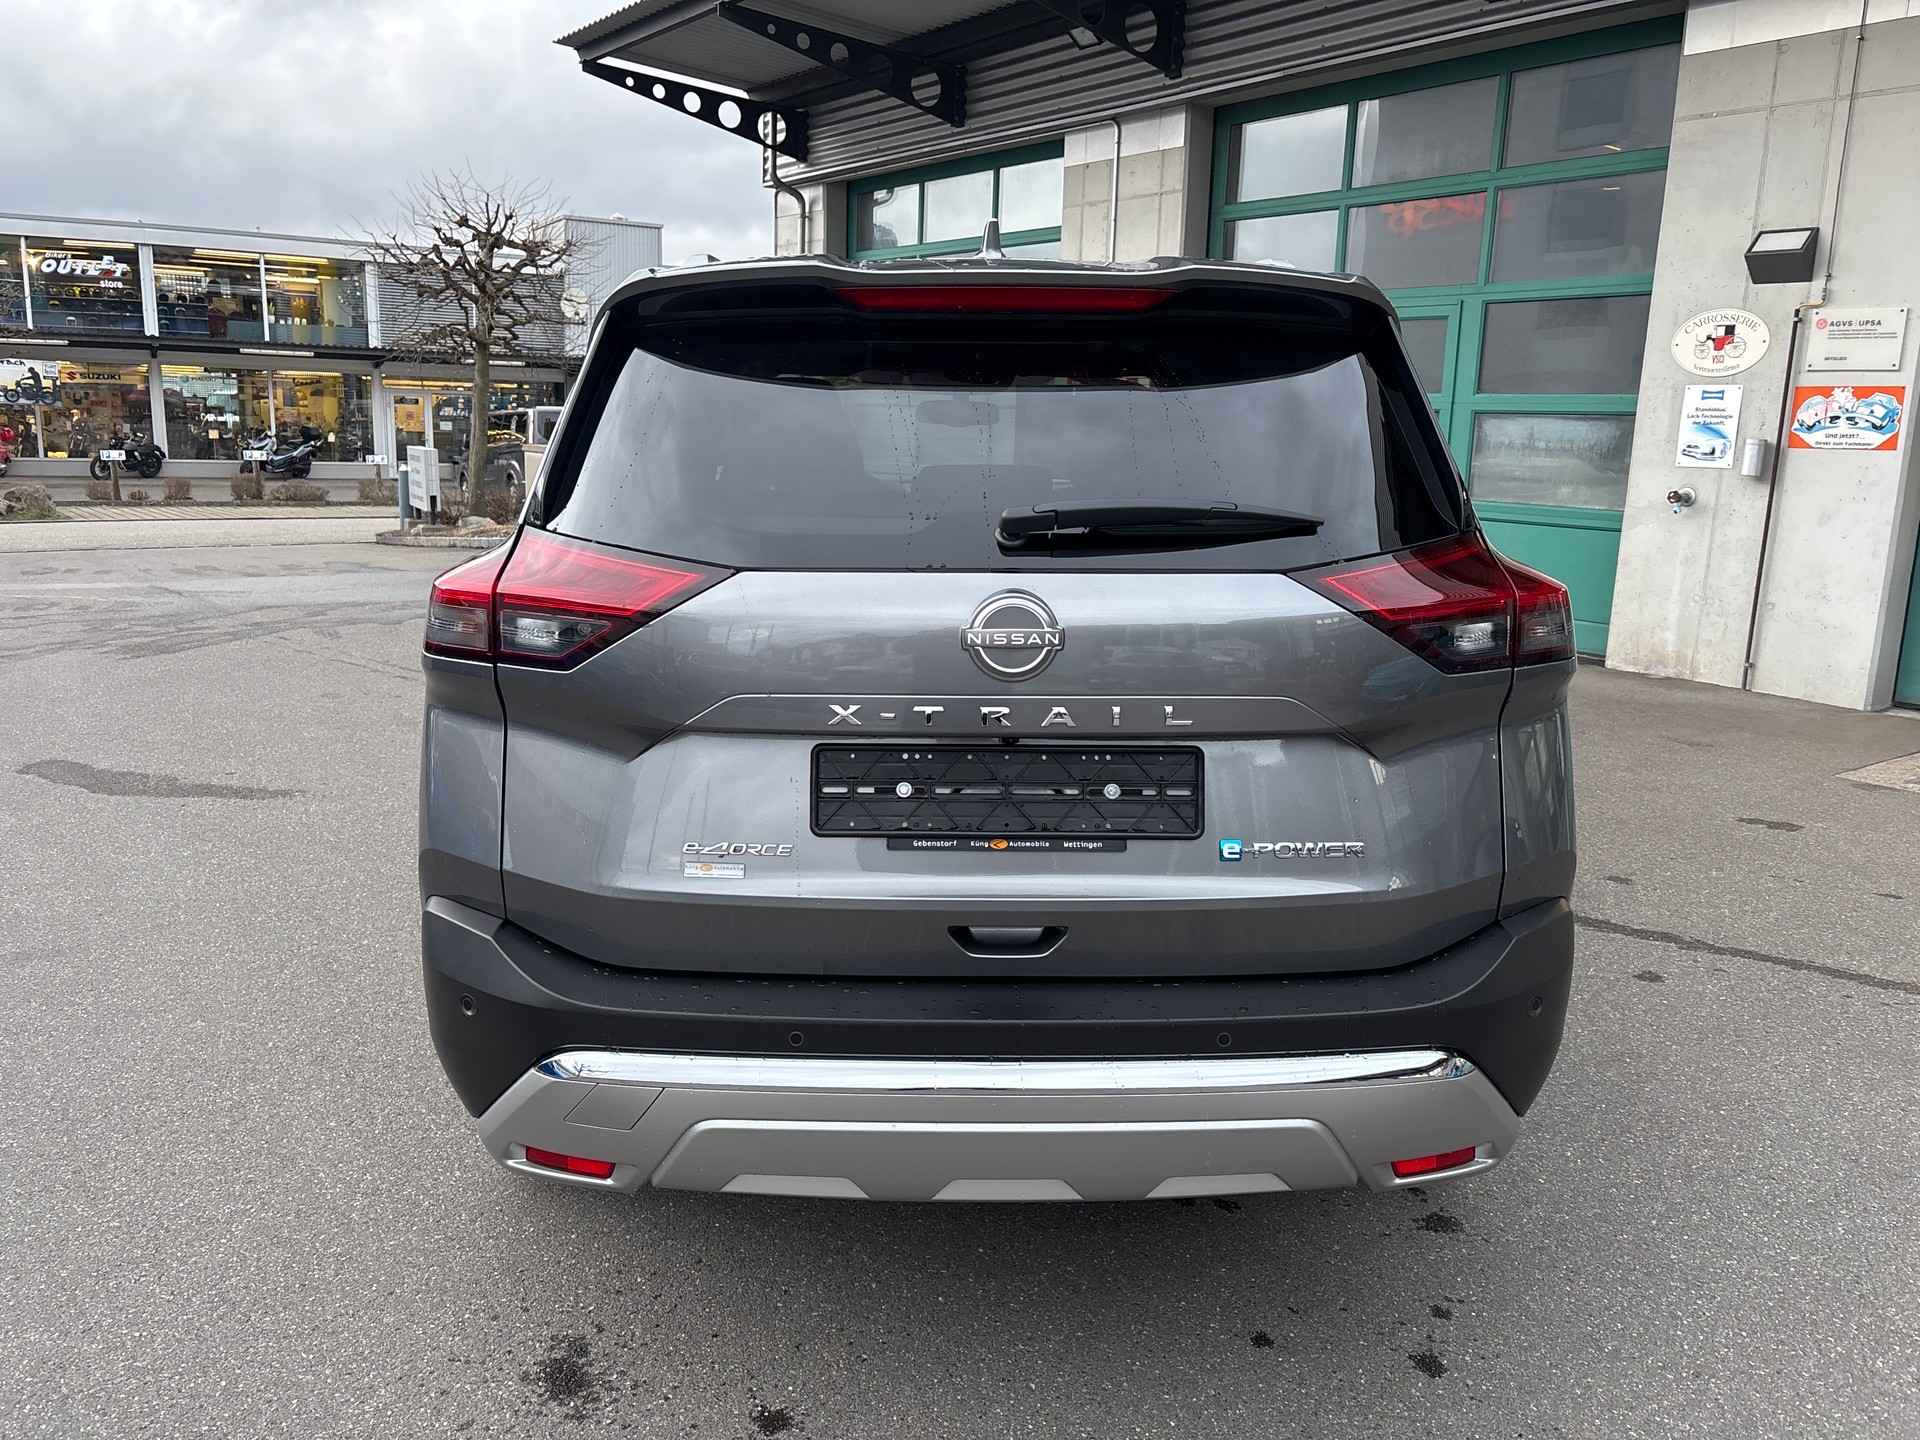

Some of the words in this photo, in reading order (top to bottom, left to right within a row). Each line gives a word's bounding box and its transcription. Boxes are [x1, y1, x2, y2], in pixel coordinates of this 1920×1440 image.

[41, 255, 131, 278] OUTLET
[100, 279, 123, 288] store
[1684, 313, 1761, 334] CARROSSERIE
[80, 373, 122, 381] SUZUKI
[967, 632, 1060, 646] NISSAN
[827, 704, 1194, 728] X-TRAIL
[913, 839, 957, 847] Gebenstorf
[970, 839, 989, 848] Küng
[1009, 840, 1050, 848] Automobile
[1063, 840, 1103, 849] Wettingen
[1220, 840, 1366, 860] e-POWER
